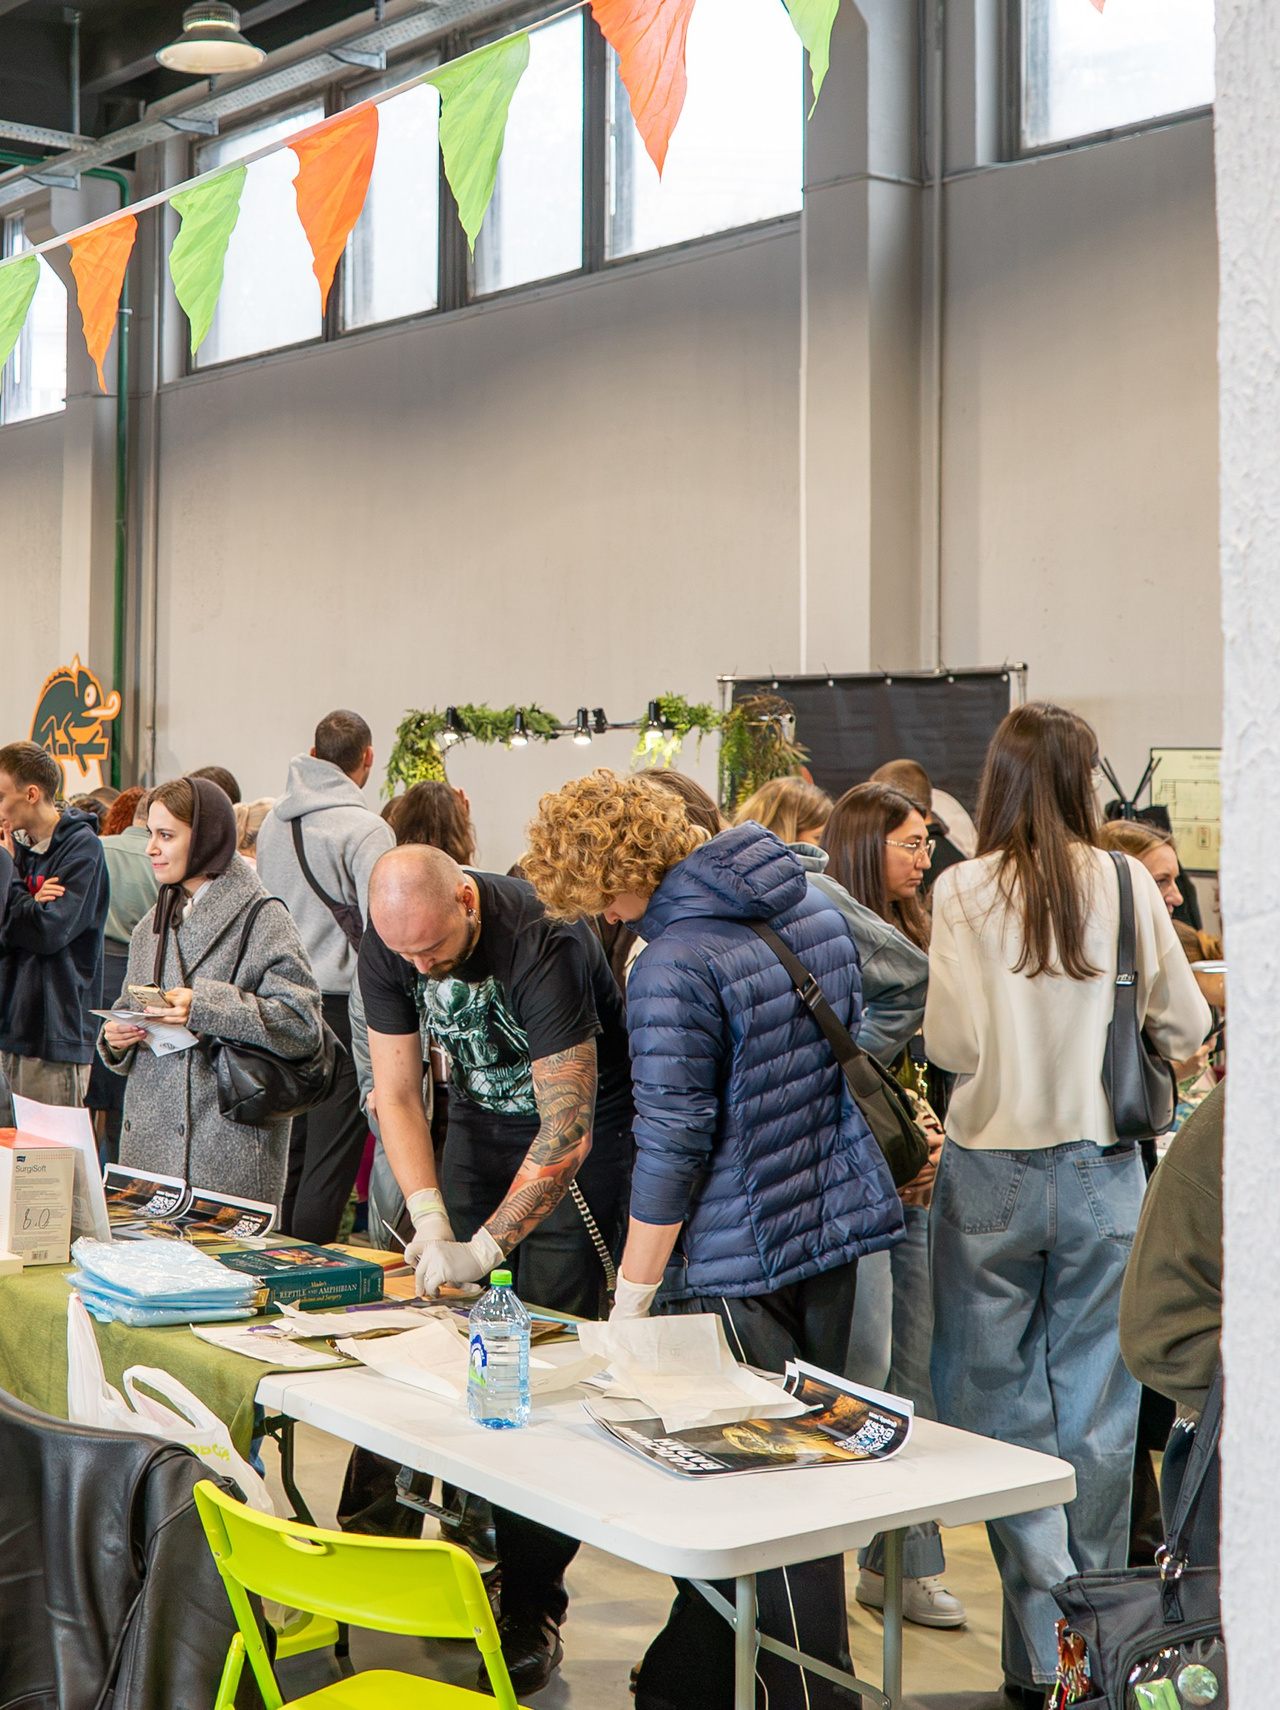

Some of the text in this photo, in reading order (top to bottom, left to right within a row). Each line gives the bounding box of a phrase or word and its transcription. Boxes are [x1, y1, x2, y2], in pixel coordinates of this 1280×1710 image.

[15, 1164, 47, 1174] SurgiSoft
[279, 1289, 306, 1299] REPTILE
[319, 1283, 358, 1295] AMPHIBIAN
[652, 1438, 726, 1471] ВАРАН
